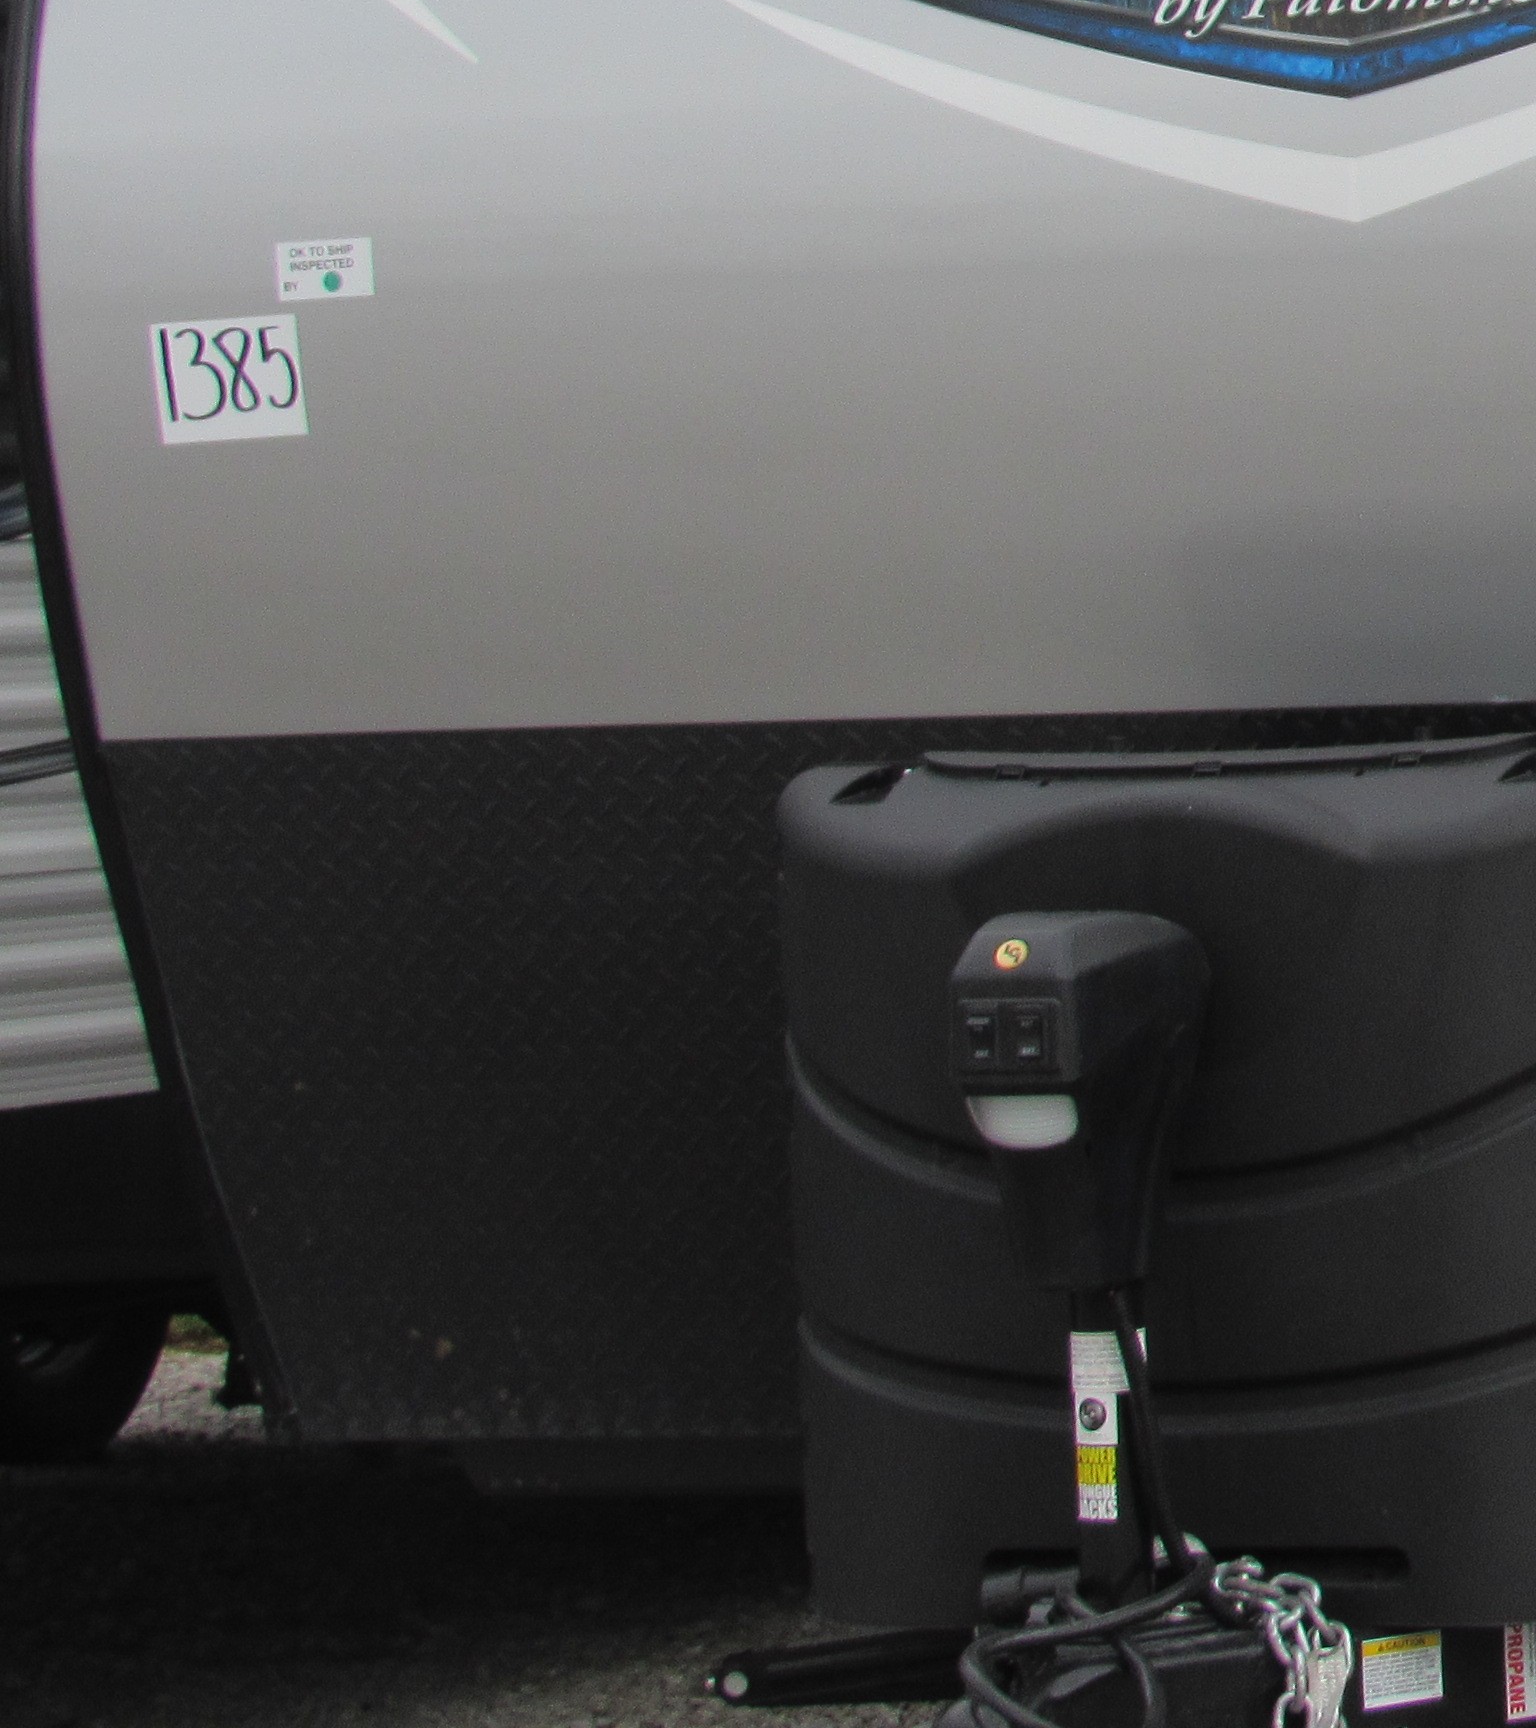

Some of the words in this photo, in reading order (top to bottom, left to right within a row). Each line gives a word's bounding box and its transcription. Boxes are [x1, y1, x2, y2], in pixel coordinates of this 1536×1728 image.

[288, 246, 306, 258] OK
[309, 245, 325, 257] TO
[327, 244, 354, 256] SHIP
[289, 258, 355, 272] INSPECTED
[283, 281, 299, 292] BY
[159, 325, 299, 422] 1385
[1507, 1623, 1526, 1715] PROPANE
